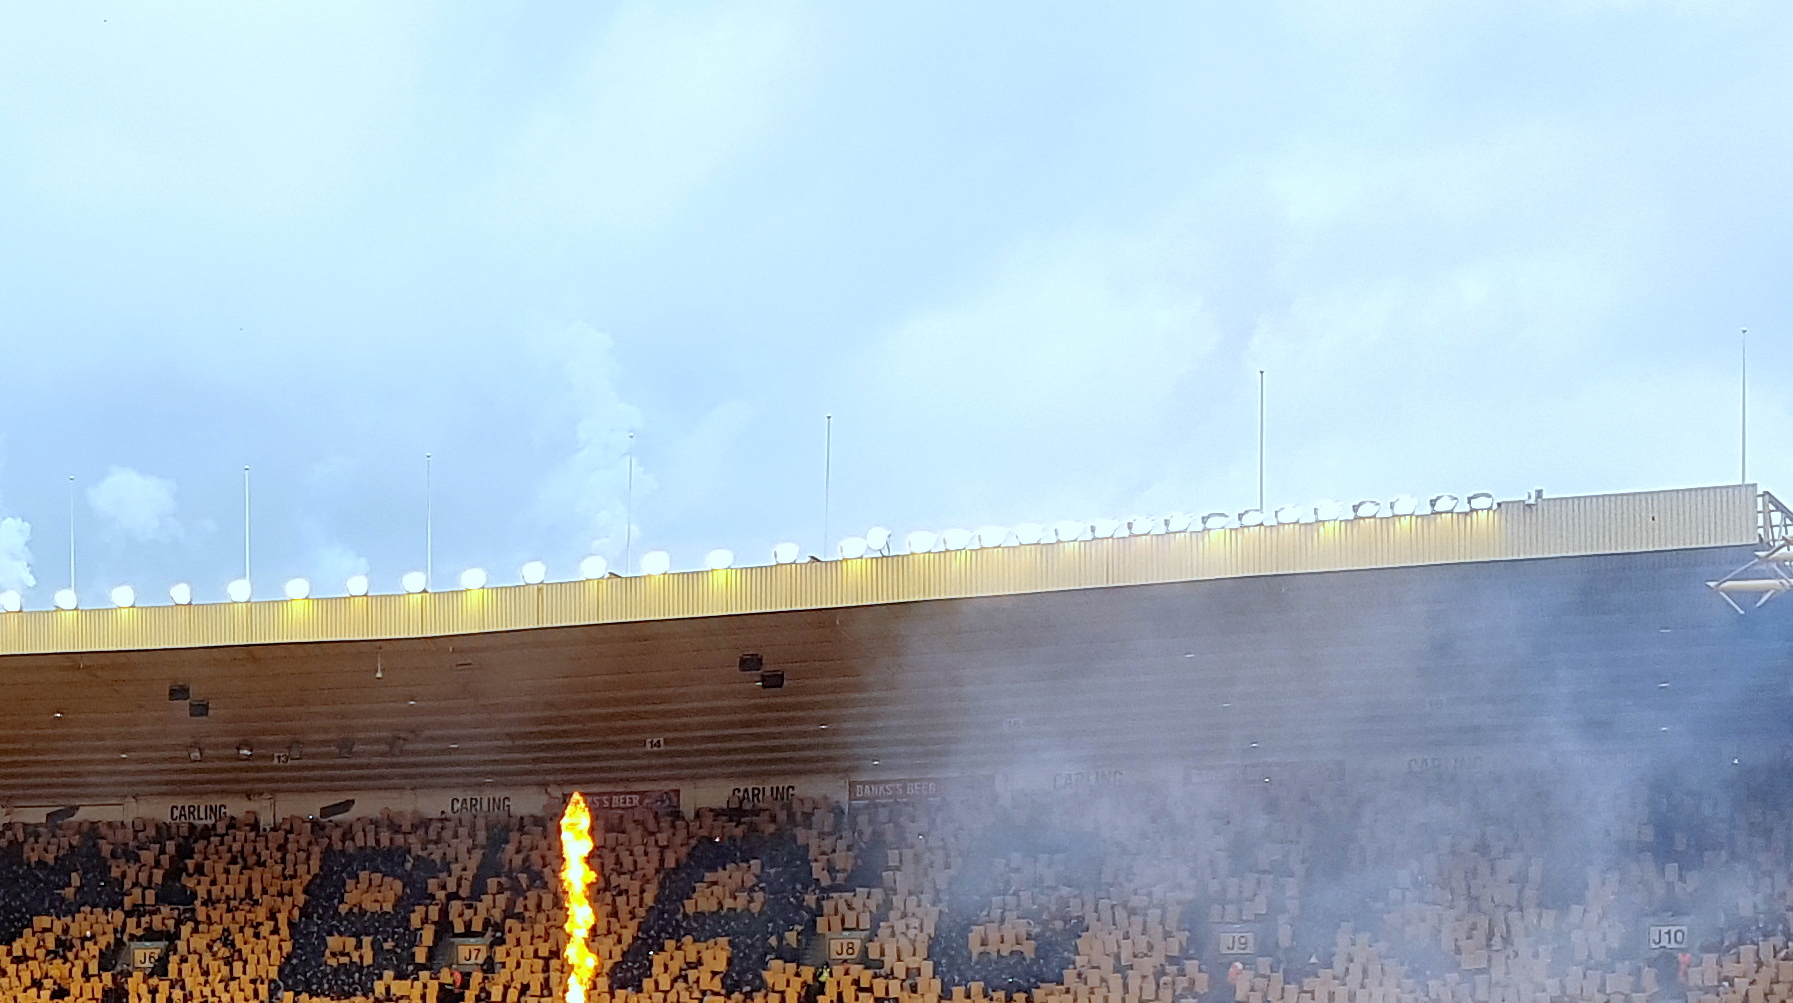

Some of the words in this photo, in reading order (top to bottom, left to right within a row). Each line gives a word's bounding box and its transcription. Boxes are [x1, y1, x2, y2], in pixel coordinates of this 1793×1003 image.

[451, 796, 511, 814] CARLING
[612, 794, 640, 808] BEER
[170, 804, 228, 821] CARLING
[1227, 935, 1248, 950] J9
[1652, 929, 1685, 946] J10
[464, 948, 481, 962] J7
[836, 942, 856, 956] J8
[139, 952, 157, 965] J6
